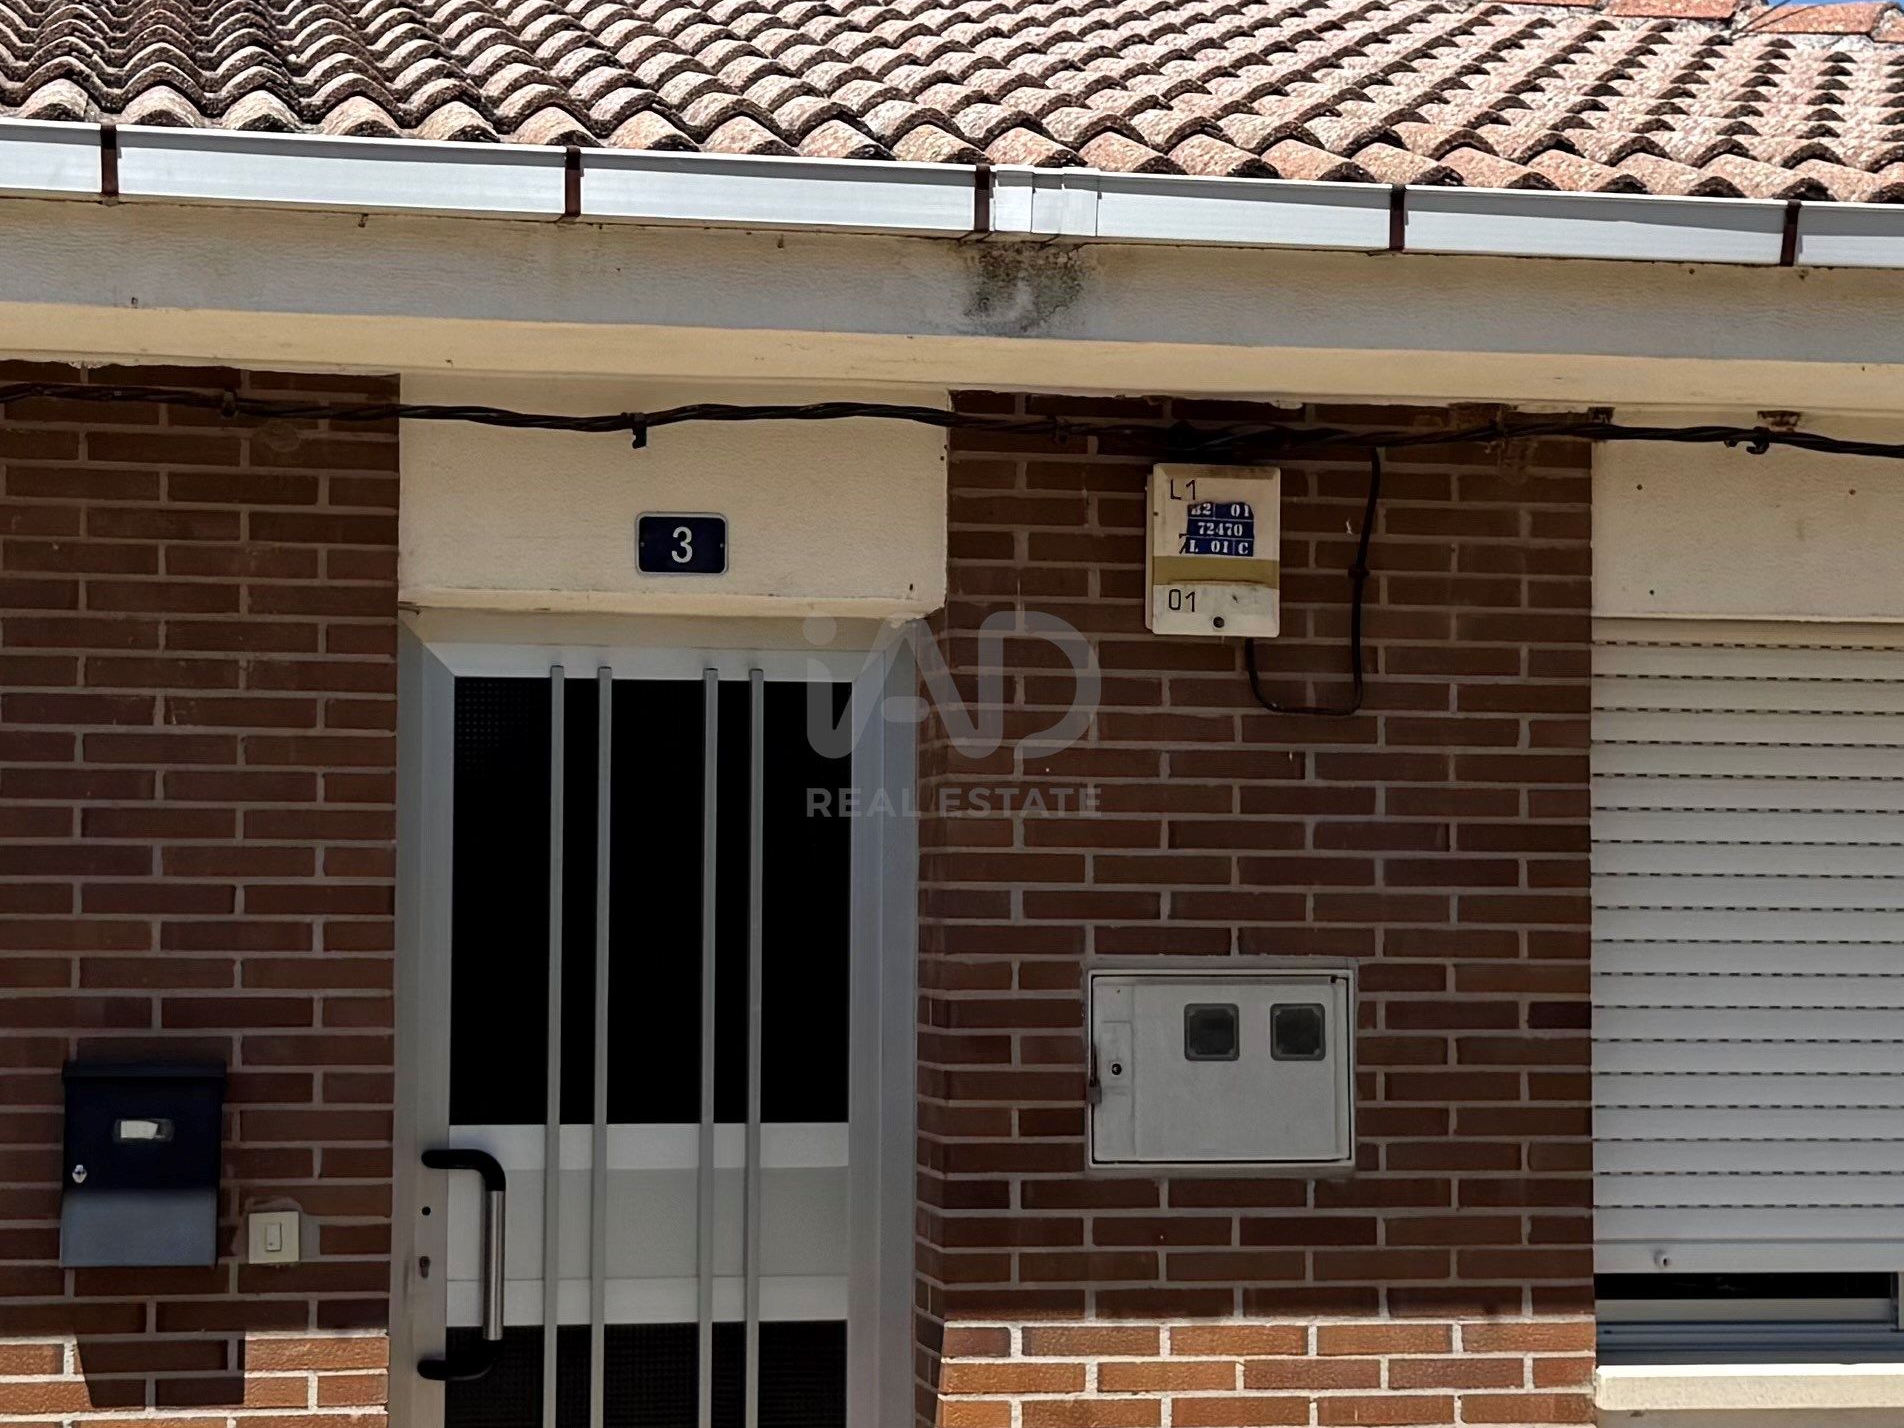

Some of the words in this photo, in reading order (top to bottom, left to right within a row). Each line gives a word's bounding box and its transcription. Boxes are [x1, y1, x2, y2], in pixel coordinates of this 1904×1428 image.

[1197, 522, 1243, 537] 72470
[671, 526, 693, 563] 3
[1238, 542, 1249, 555] C
